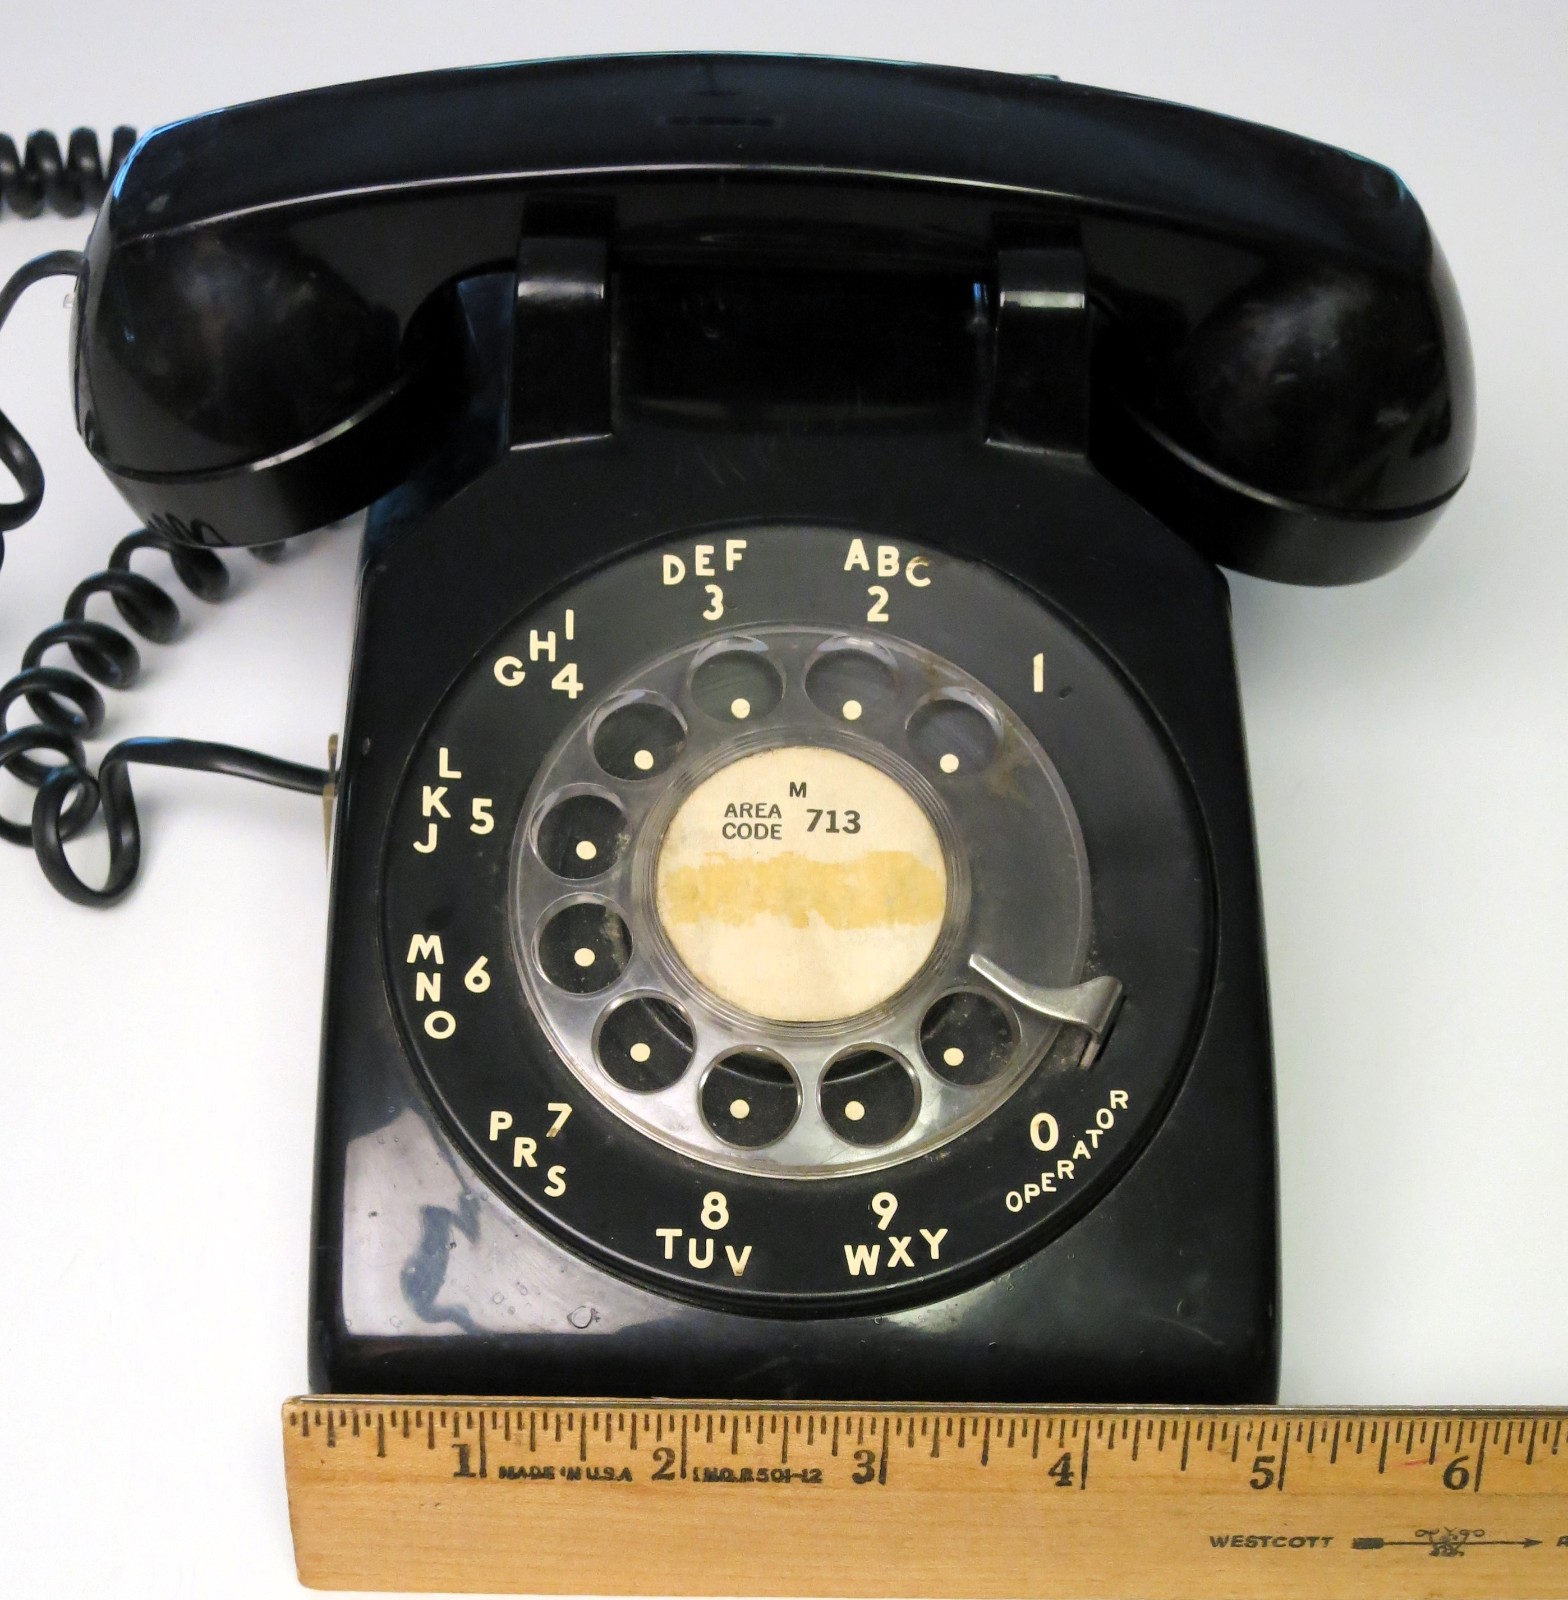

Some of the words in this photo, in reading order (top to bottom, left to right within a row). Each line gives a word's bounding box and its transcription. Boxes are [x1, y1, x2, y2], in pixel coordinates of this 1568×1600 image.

[662, 539, 748, 586] DEF
[843, 538, 932, 588] ABC
[702, 583, 724, 621] 3
[866, 585, 890, 623] 2
[493, 608, 575, 687] GHI
[551, 662, 584, 700] 4
[788, 781, 807, 798] M
[469, 797, 495, 835] 5
[723, 802, 782, 819] AREA
[806, 808, 861, 834] 713
[721, 822, 783, 840] CODE
[406, 933, 457, 1040] MNO
[464, 955, 491, 994] 6
[545, 1102, 573, 1138] 7
[489, 1110, 567, 1198] PRS
[1005, 1089, 1129, 1213] OPERATOR
[700, 1191, 730, 1231] 8
[871, 1191, 899, 1231] 9
[655, 1228, 753, 1277] TUV
[843, 1228, 949, 1276] WXY
[452, 1444, 476, 1478] 1
[499, 1466, 555, 1480] MADE
[651, 1447, 676, 1481] 2
[852, 1449, 876, 1484] 3
[1048, 1453, 1074, 1488] 4
[1249, 1455, 1276, 1490] 5
[1442, 1455, 1470, 1490] 6
[1209, 1535, 1334, 1549] WESTCOTT
